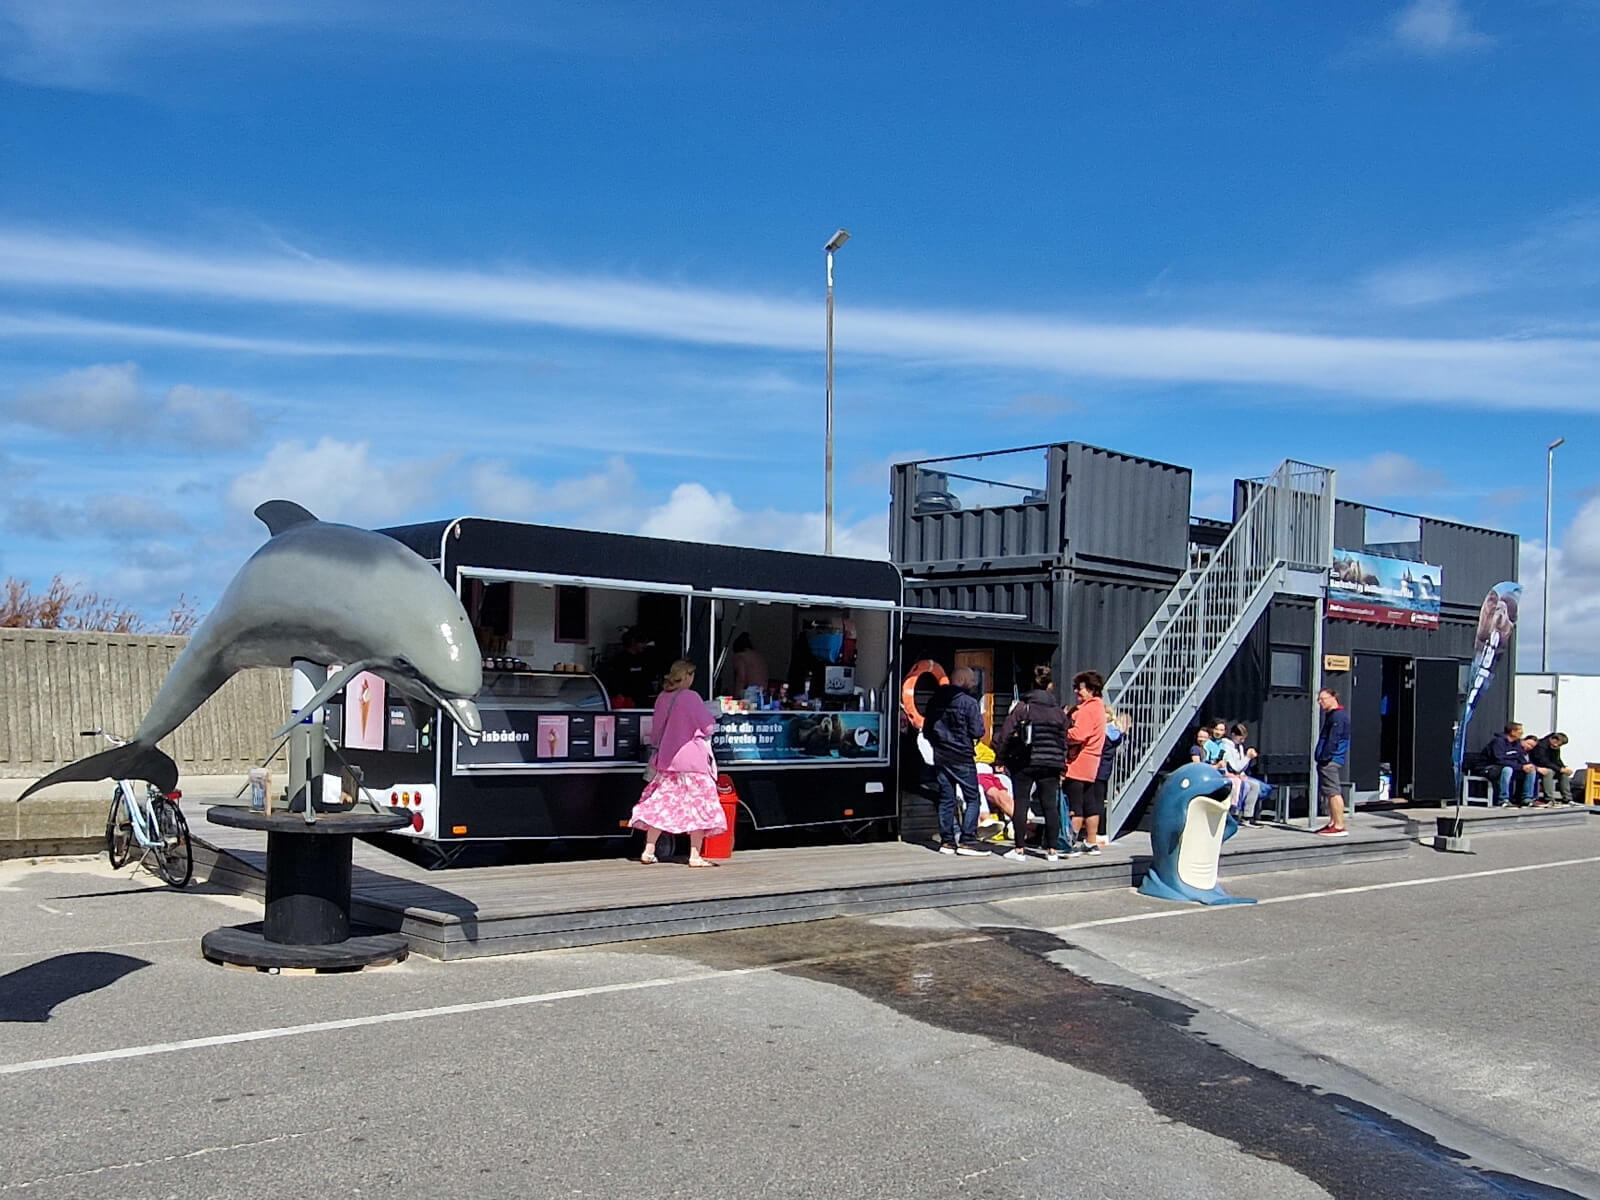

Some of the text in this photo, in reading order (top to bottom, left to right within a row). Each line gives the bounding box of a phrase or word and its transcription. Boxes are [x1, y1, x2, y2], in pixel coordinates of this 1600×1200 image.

[714, 721, 783, 733] Book din næste
[713, 734, 775, 745] oplevelse her
